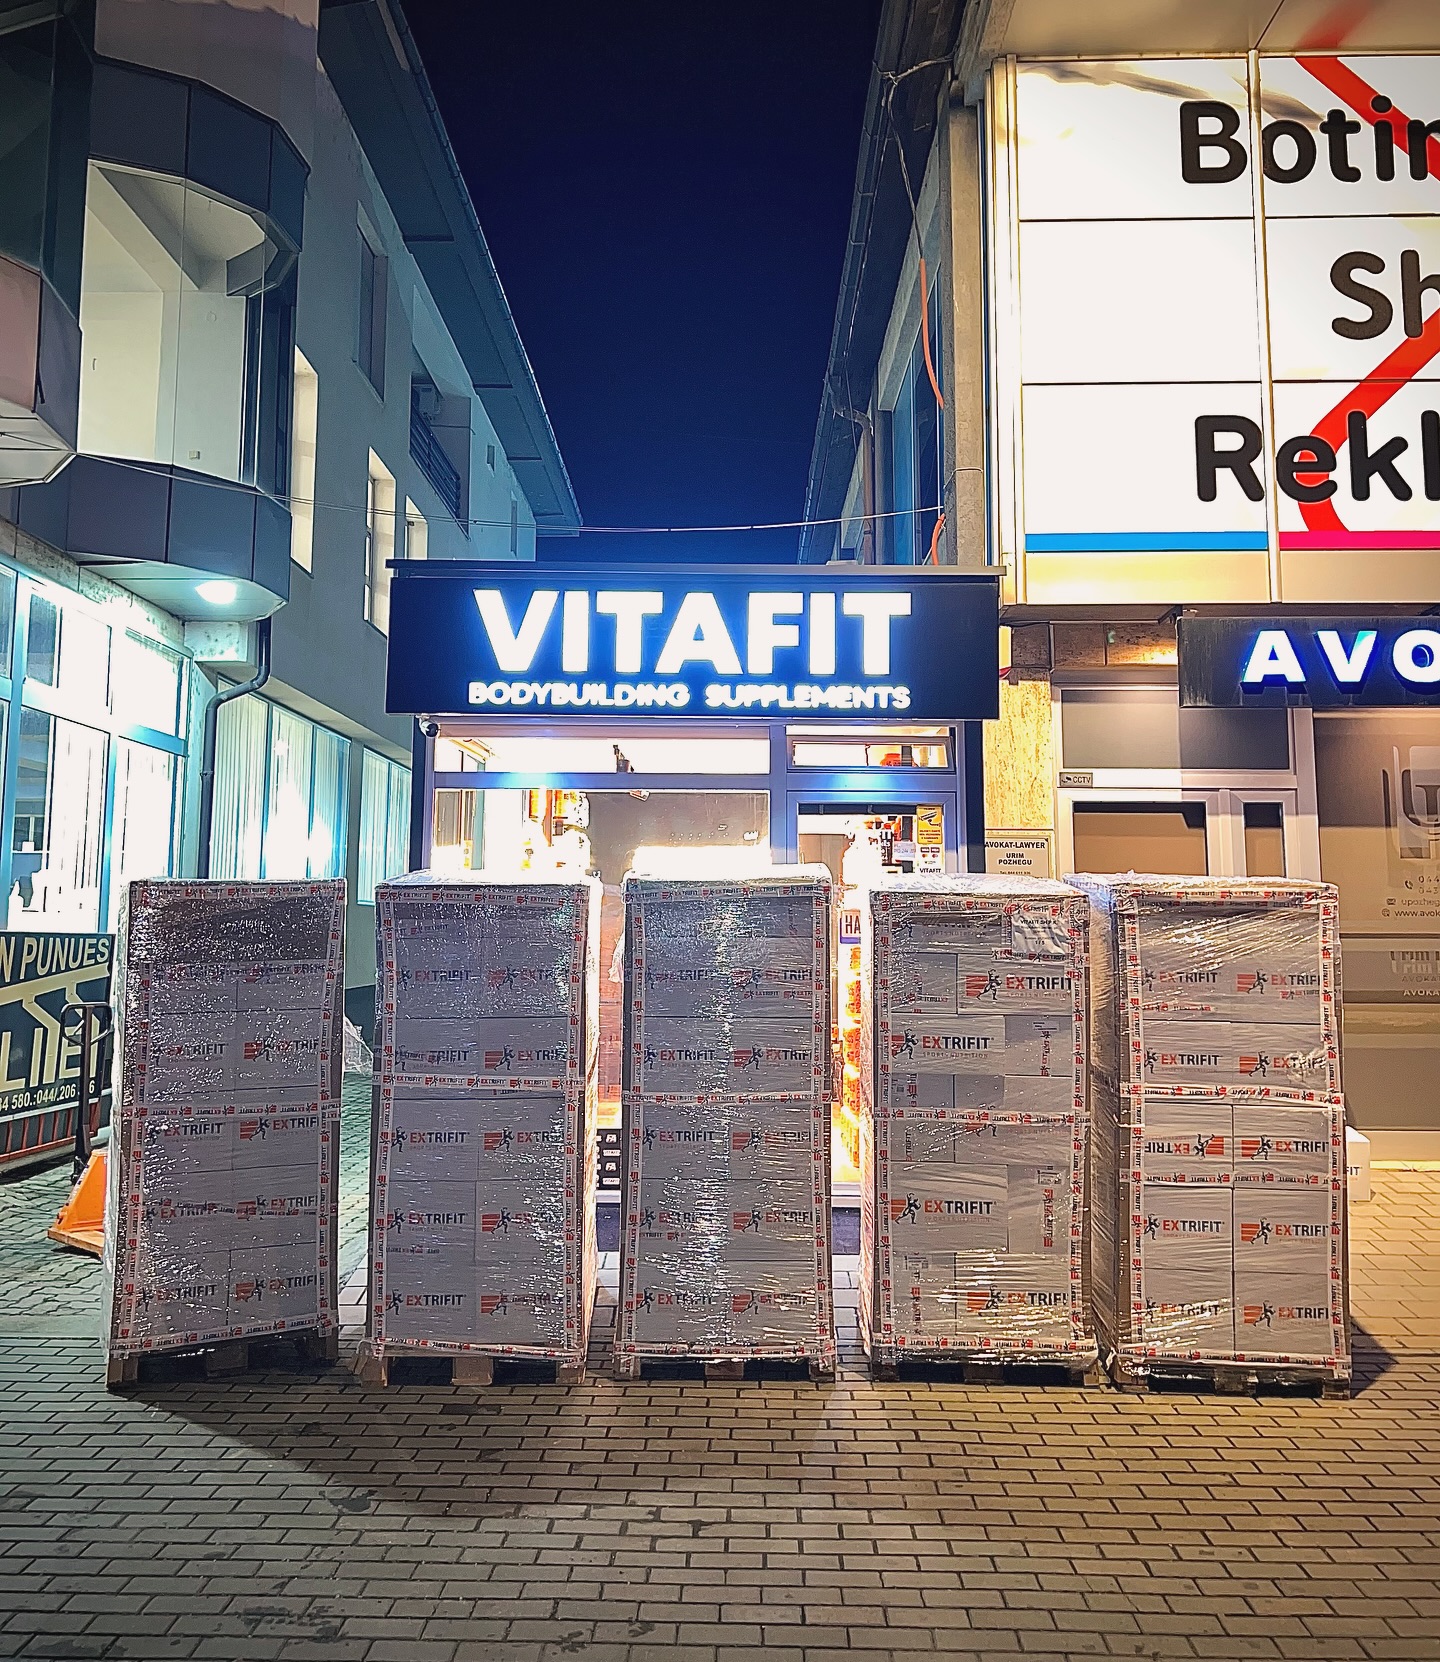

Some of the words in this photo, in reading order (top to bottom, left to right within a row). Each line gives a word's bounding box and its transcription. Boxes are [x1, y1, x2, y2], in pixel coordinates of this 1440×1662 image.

[1330, 249, 1440, 339] Sh
[474, 589, 911, 676] VITAFIT
[1242, 630, 1440, 688] AVO
[469, 681, 690, 706] BODYBUILDING
[705, 684, 911, 709] SUPPLEMENTS
[19, 937, 109, 980] PUNUES
[415, 970, 472, 981] EXTRIFIT
[1160, 972, 1218, 983] EXTRIFIT
[922, 1037, 990, 1049] EXTRIFIT
[660, 1050, 715, 1061] EXTRIFIT
[1161, 1054, 1219, 1066] EXTRIFIT
[165, 1123, 223, 1137] EXTRIFIT
[410, 1132, 466, 1144] EXTRIFIT
[659, 1131, 714, 1142] EXTRIFIT
[924, 1200, 993, 1215] EXTRIFIT
[408, 1213, 465, 1224] EXTRIFIT
[1163, 1220, 1222, 1233] EXTRIFIT
[407, 1295, 464, 1307] EXTRIFIT
